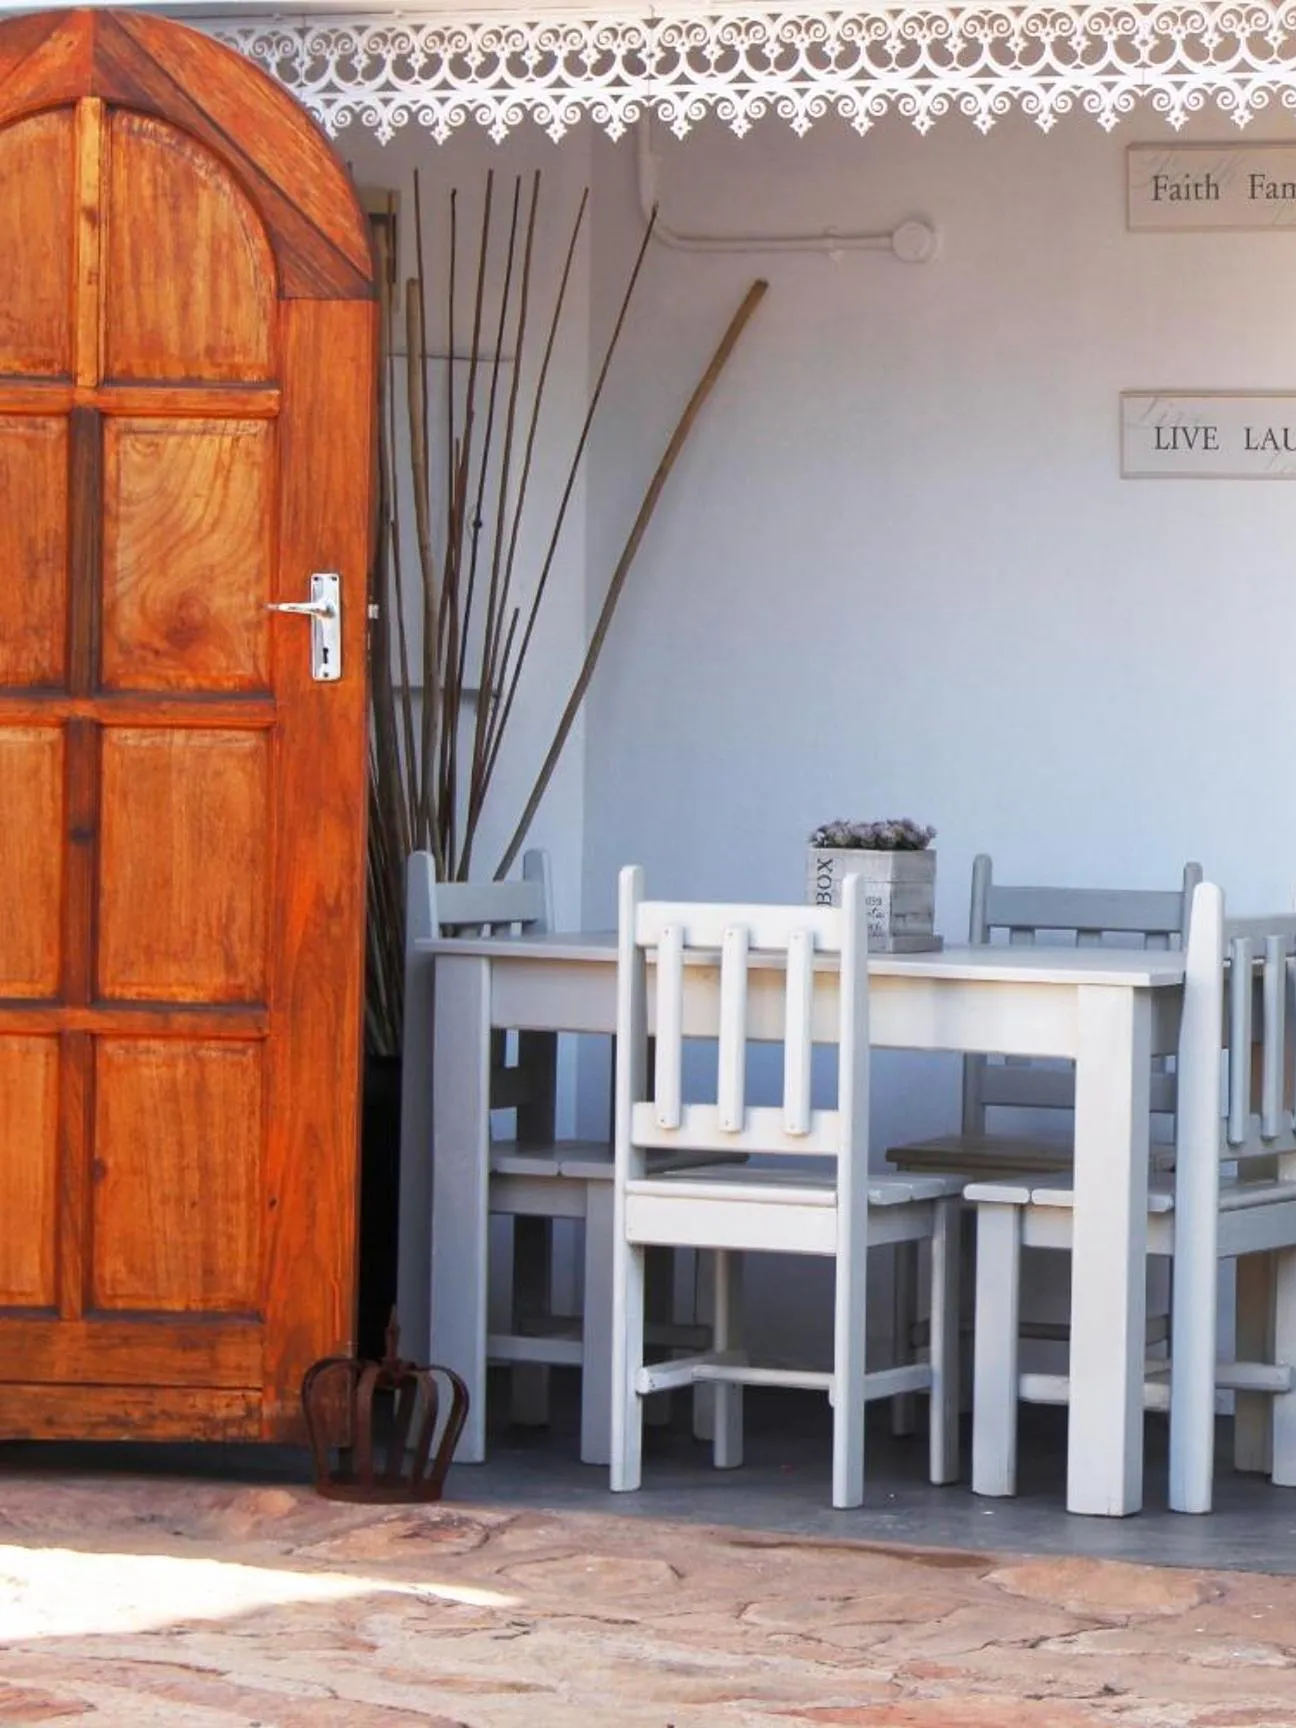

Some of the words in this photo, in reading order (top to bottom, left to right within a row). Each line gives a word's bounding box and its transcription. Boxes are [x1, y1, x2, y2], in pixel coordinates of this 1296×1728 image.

[1152, 173, 1220, 201] Faith
[1154, 426, 1220, 450] LIVE
[816, 858, 833, 906] BOX
